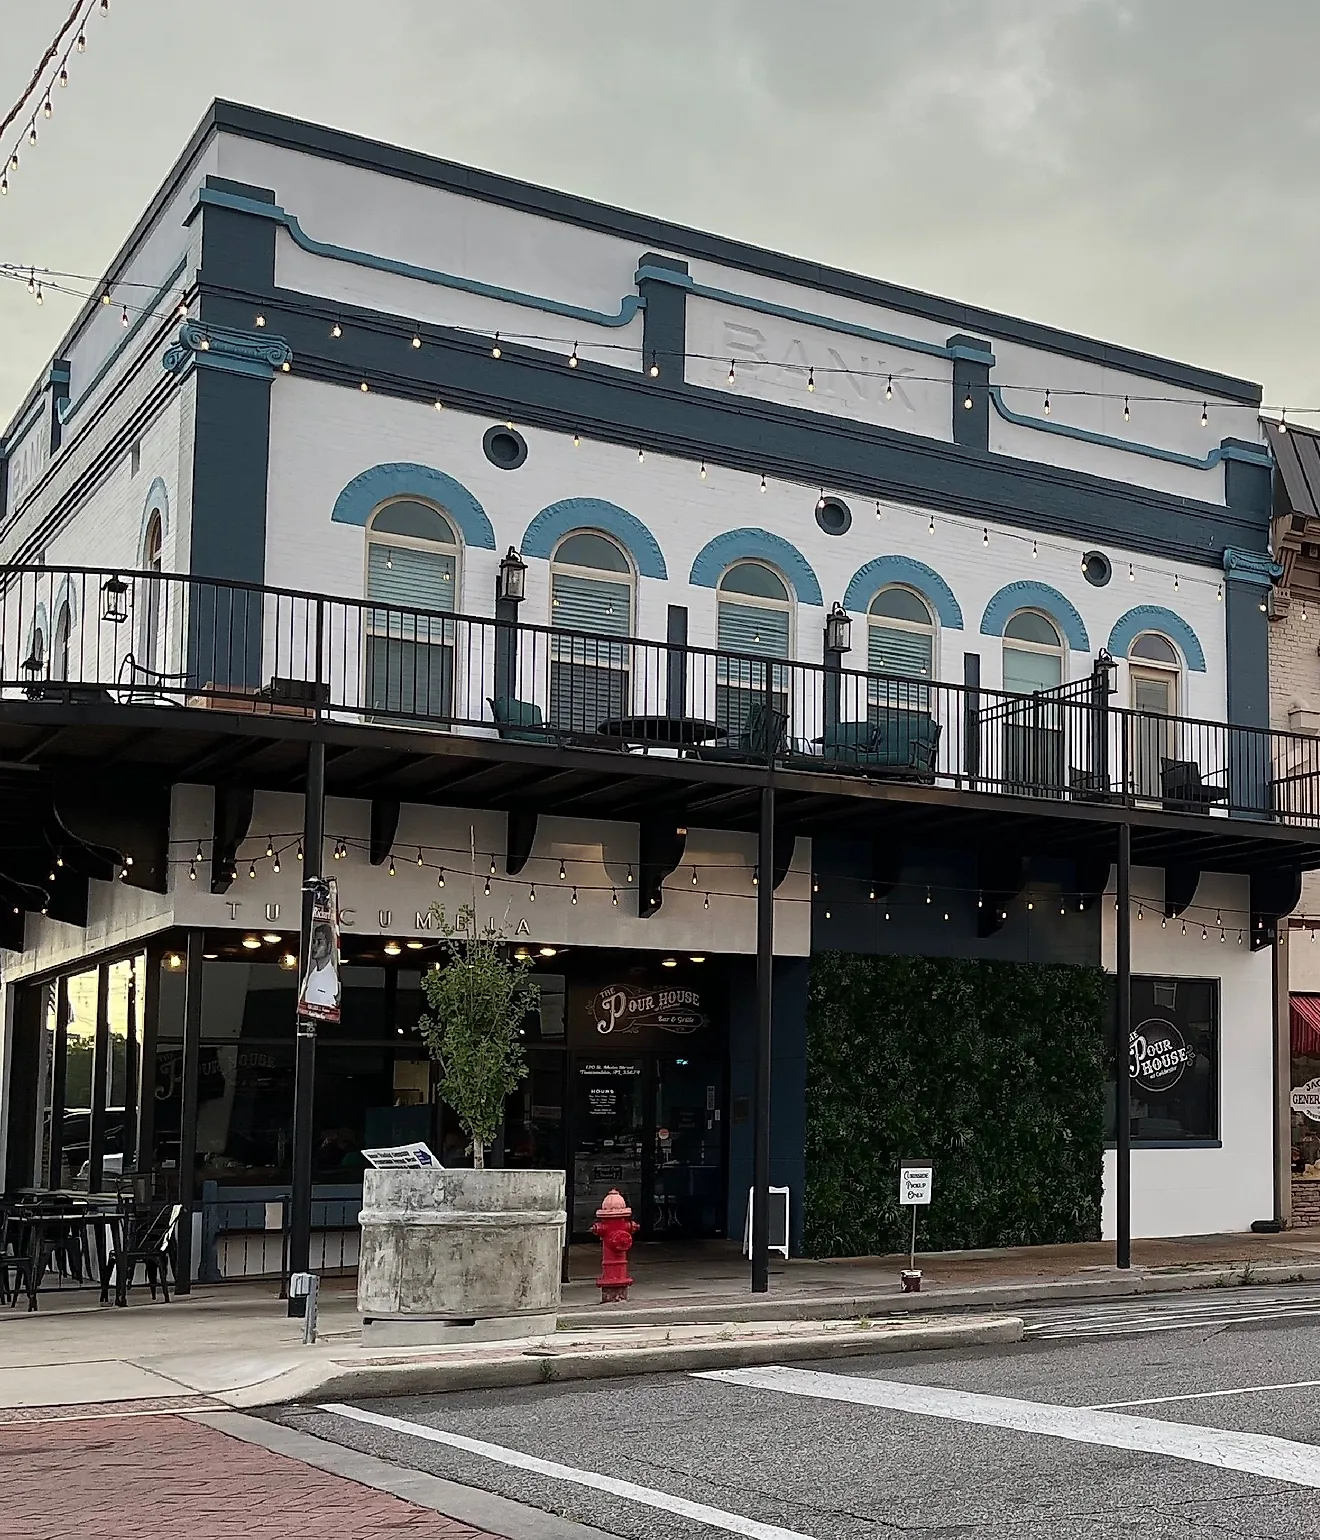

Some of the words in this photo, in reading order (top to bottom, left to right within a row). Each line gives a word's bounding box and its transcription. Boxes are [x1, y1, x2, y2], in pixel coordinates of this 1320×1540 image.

[713, 321, 916, 411] BANK
[225, 902, 531, 936] TUCUMBIA
[597, 991, 655, 1034] POUR
[658, 990, 700, 1007] HOUSE
[657, 1015, 670, 1023] Bar
[1129, 1035, 1173, 1078] POUR
[1140, 1048, 1188, 1076] HOUSE
[905, 1180, 927, 1190] PICKUP
